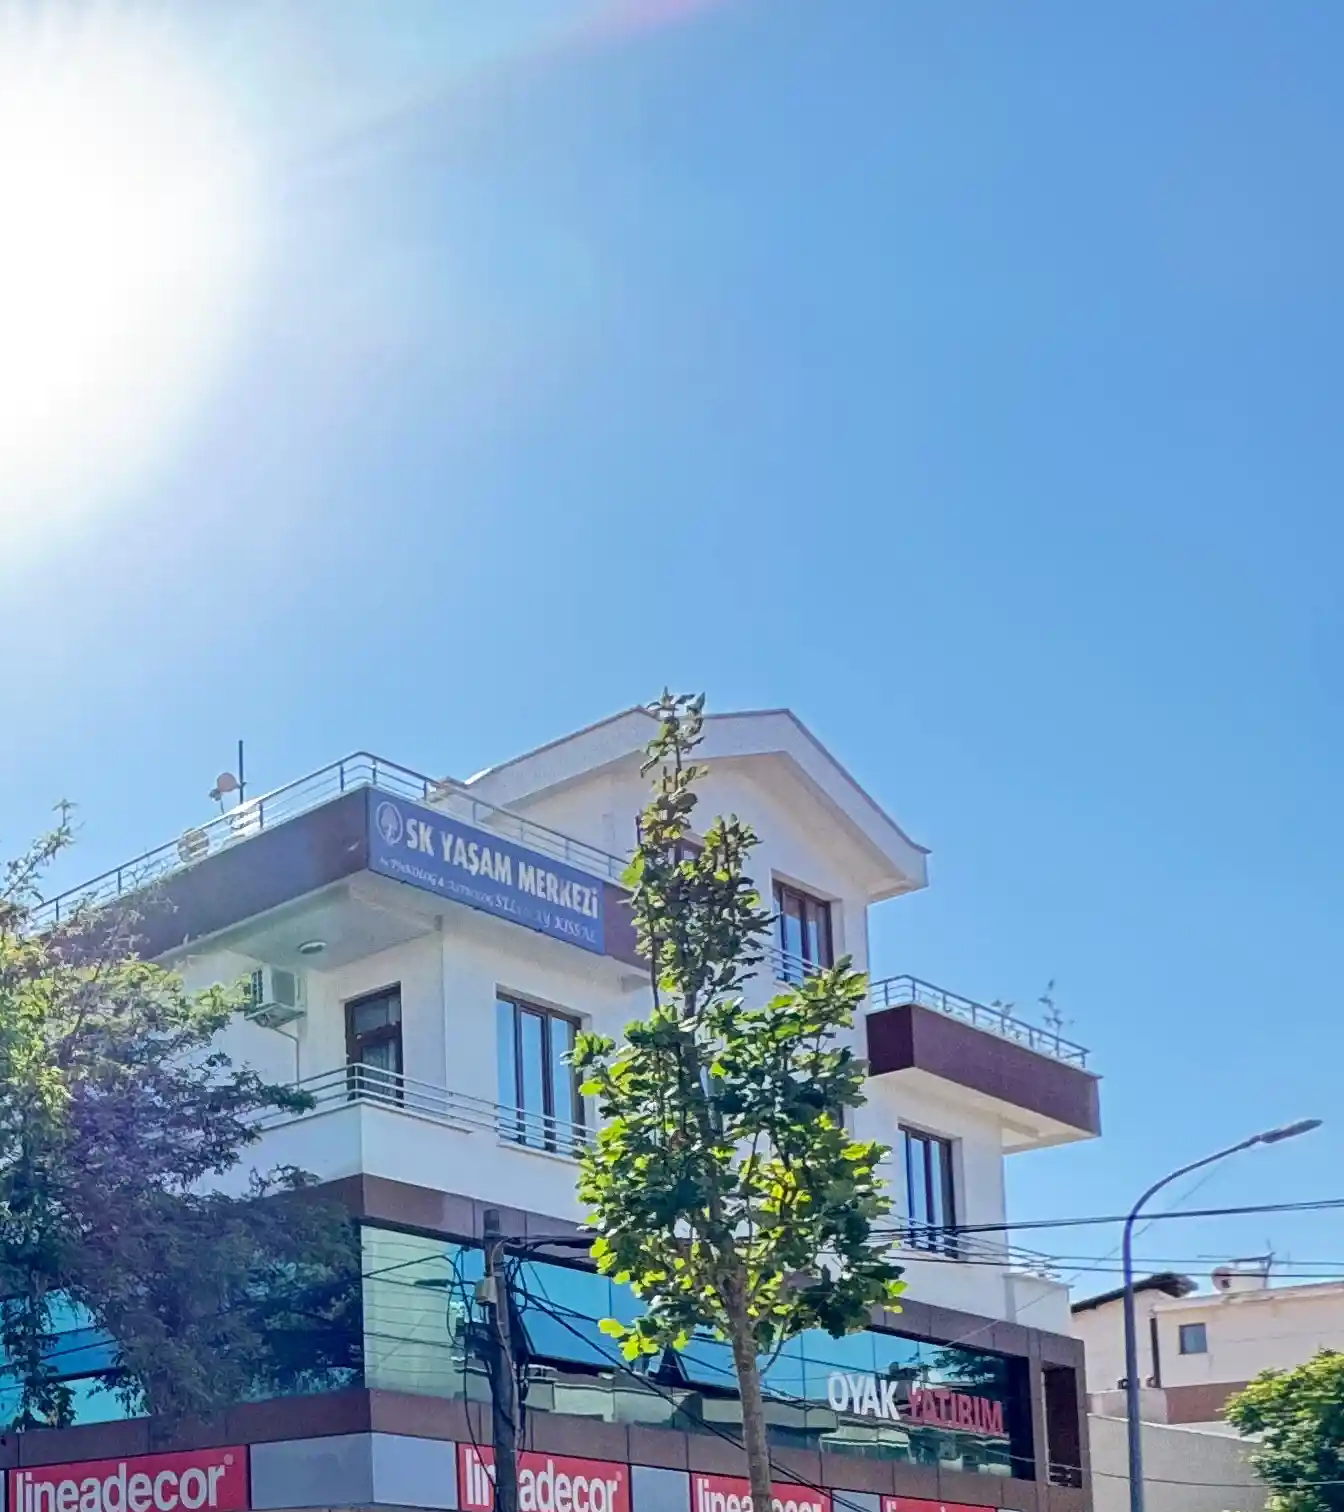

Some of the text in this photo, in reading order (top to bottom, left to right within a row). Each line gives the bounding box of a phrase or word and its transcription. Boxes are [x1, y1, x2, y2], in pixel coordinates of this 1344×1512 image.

[406, 818, 599, 919] SK YAŞAM MERKEZİ
[827, 1371, 1004, 1435] OYAK YATIRIM
